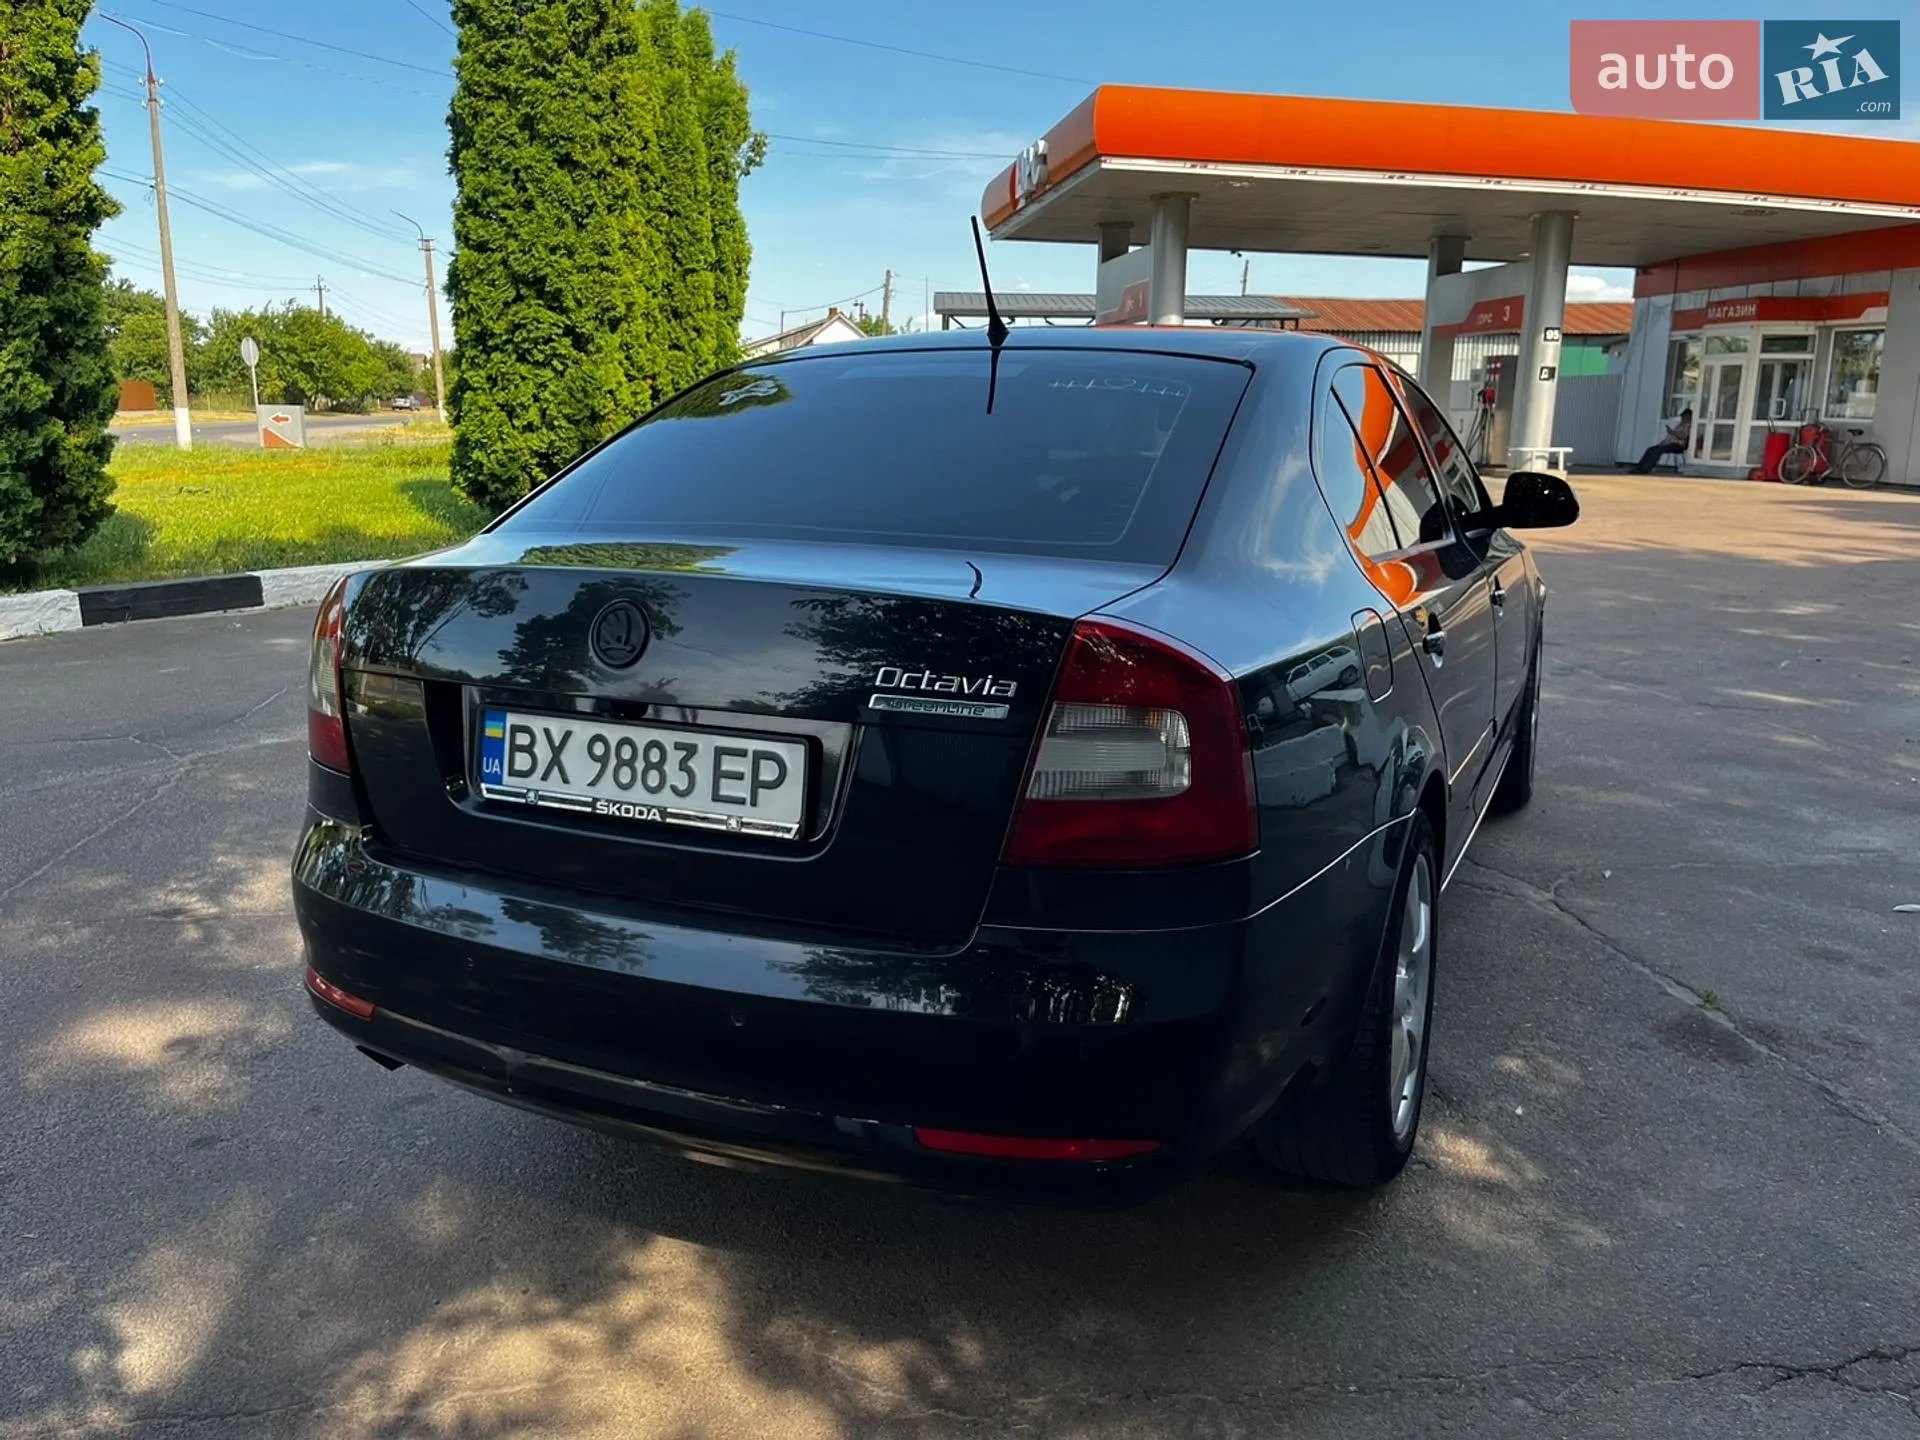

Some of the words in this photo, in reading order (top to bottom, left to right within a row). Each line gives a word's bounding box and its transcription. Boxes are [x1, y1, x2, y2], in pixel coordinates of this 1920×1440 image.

[1502, 304, 1511, 322] 3
[1707, 303, 1757, 319] МАГАЗИН
[1545, 328, 1560, 340] 95
[874, 666, 1018, 697] Octavia
[483, 756, 502, 775] UA
[507, 723, 573, 785] BX
[586, 732, 698, 798] 9883
[711, 744, 788, 808] EP
